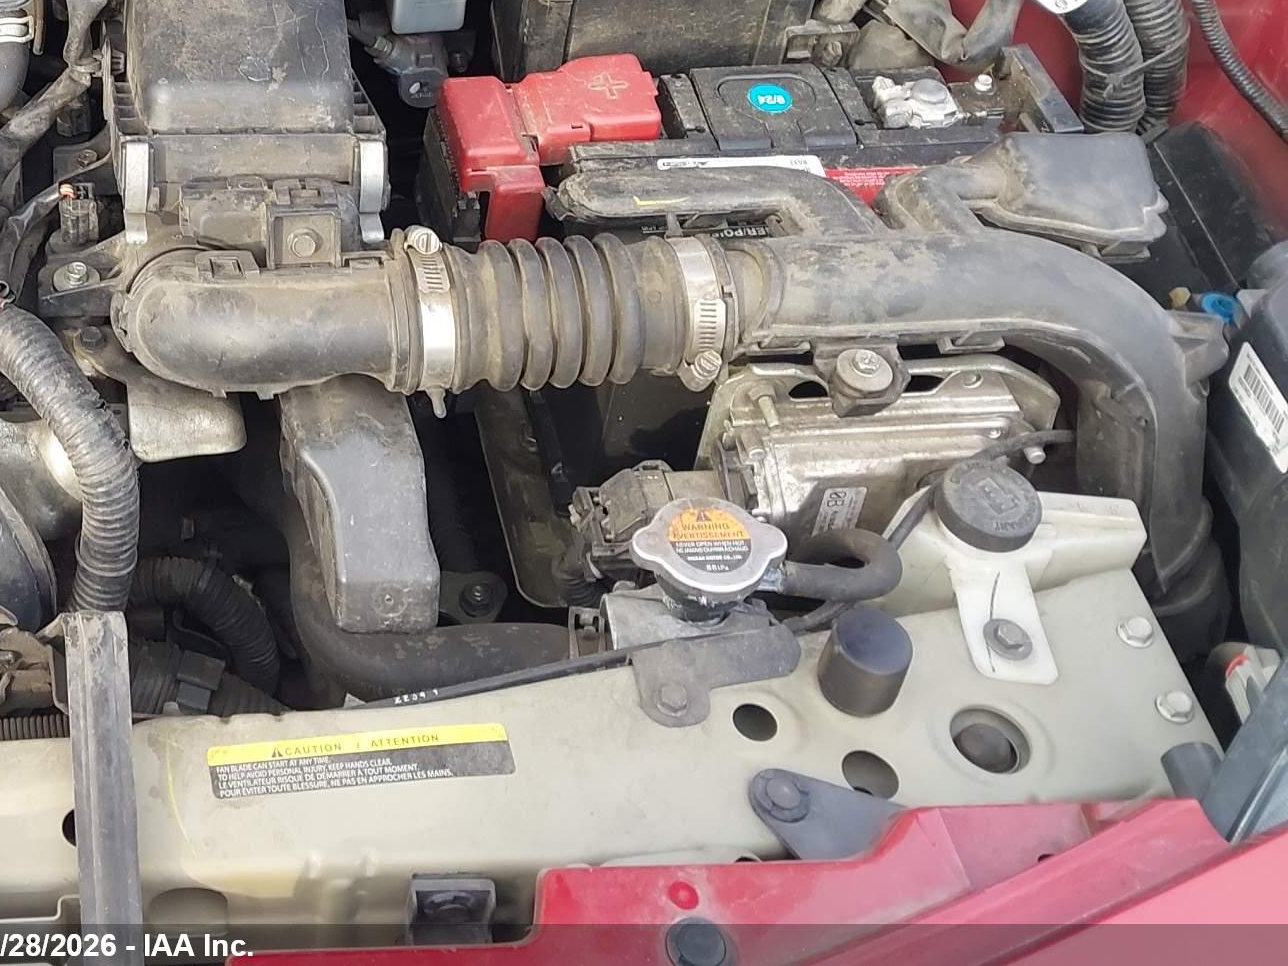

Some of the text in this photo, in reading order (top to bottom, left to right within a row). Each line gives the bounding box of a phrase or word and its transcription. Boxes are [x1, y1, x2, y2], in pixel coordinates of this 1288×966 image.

[284, 742, 342, 756] CAUTION
[371, 734, 439, 748] ATTENTION
[216, 766, 230, 774] FAN
[231, 764, 252, 772] BLADE
[253, 762, 267, 770] CAN
[268, 760, 288, 768] START
[299, 758, 313, 766] ANY
[229, 772, 246, 780] HELP
[246, 770, 267, 778] AVOID
[268, 768, 301, 776] PERSONAL
[328, 764, 344, 772] KEEP
[345, 760, 369, 768] HANDS
[220, 790, 241, 798] POUR
[268, 784, 291, 794] TOUTE
[331, 780, 341, 788] NE
[342, 777, 356, 786] PAS
[357, 776, 367, 784] EN
[369, 772, 413, 784] APPROCHER
[414, 771, 426, 779] LES
[228, 777, 276, 788] VENTILATEUR
[277, 774, 304, 784] RISQUE
[364, 767, 382, 776] TOUT
